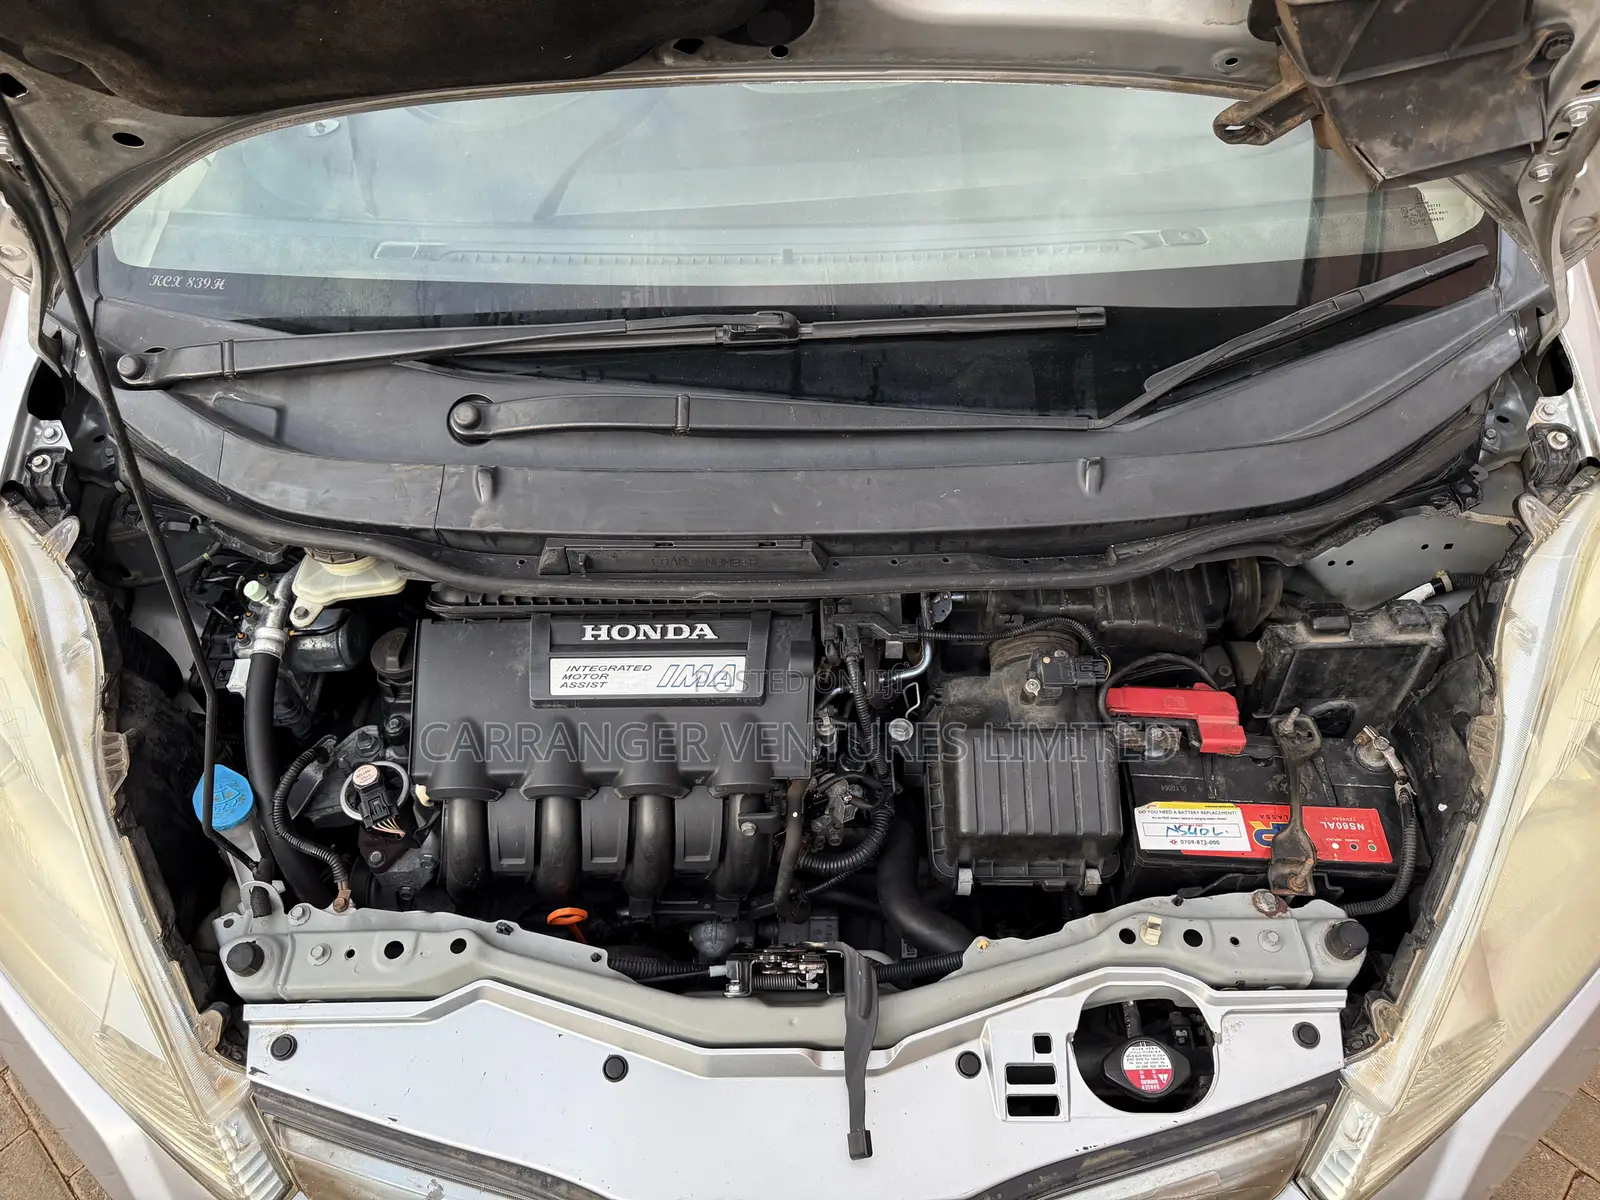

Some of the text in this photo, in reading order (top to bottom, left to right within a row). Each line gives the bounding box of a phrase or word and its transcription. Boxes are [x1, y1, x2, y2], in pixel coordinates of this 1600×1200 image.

[148, 274, 227, 291] KCX 839H
[651, 556, 758, 567] FRAME NUMBER
[581, 623, 719, 641] HONDA
[566, 664, 653, 673] INTEGRATED
[561, 673, 610, 681] MOTOR
[656, 663, 737, 689] IMA
[559, 681, 609, 689] ASSIST
[1319, 821, 1366, 831] NS60AL
